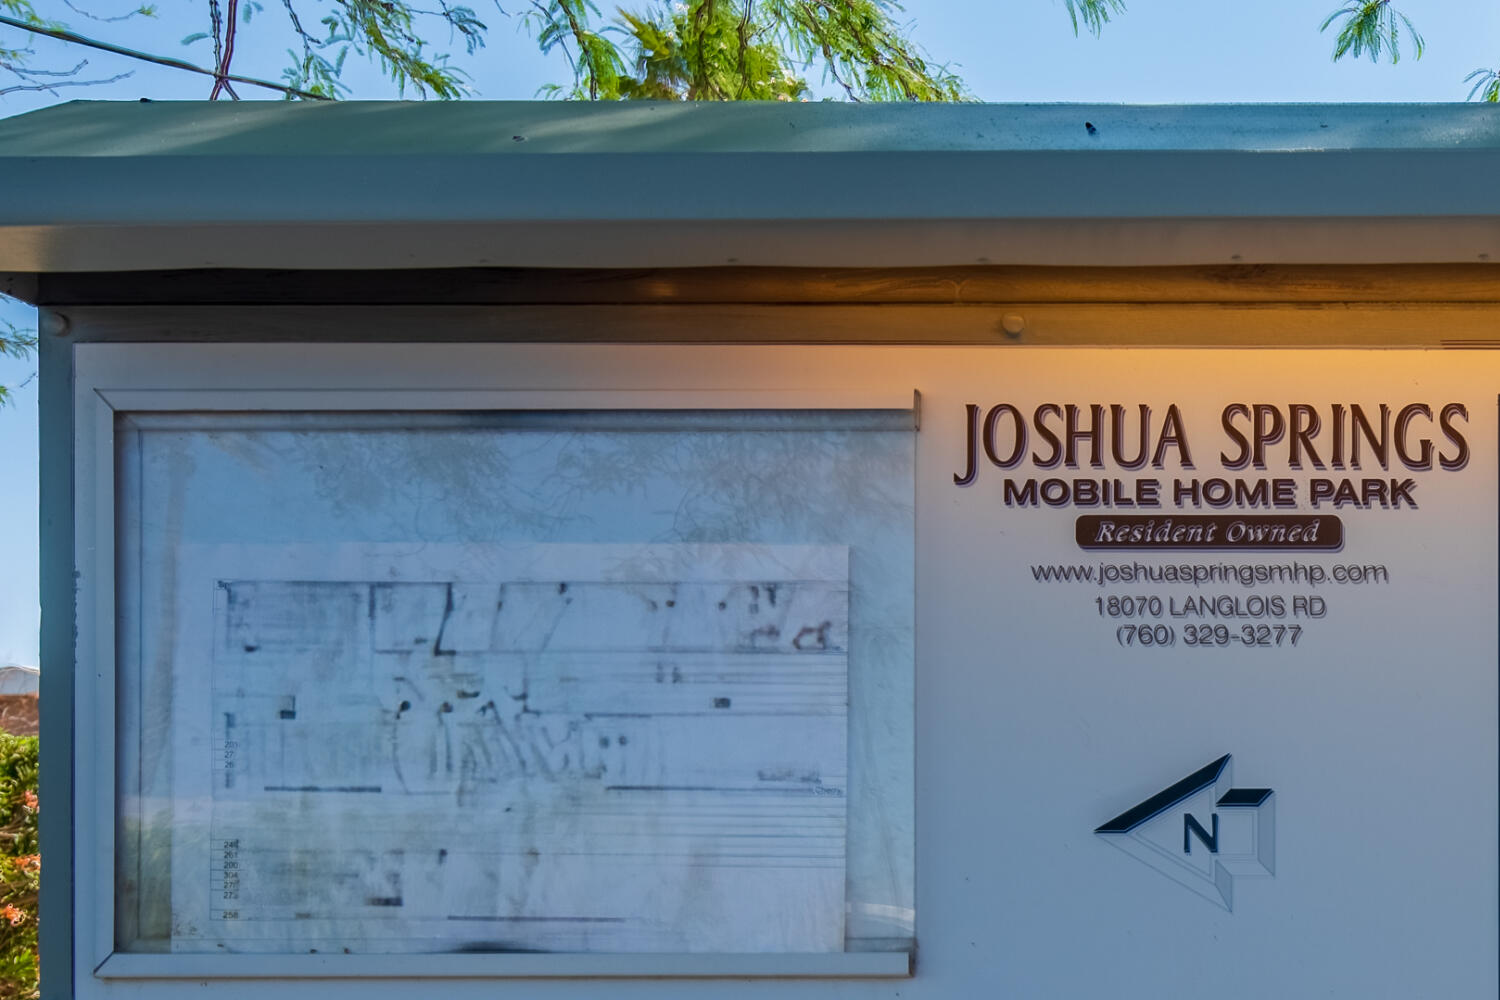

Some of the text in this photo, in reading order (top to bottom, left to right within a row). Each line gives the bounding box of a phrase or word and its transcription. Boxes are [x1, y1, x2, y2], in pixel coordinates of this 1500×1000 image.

[953, 402, 1471, 487] JOSHUA SPRINGS
[1003, 478, 1417, 508] MOBILE HOME PARK
[1094, 518, 1321, 544] Resident Owned
[1030, 561, 1389, 587] www.joshuaspringsmhp.com
[1095, 595, 1326, 617] 18070 LANGLOIS RD
[1116, 624, 1302, 646] (760) 329-3277
[1183, 812, 1219, 854] N
